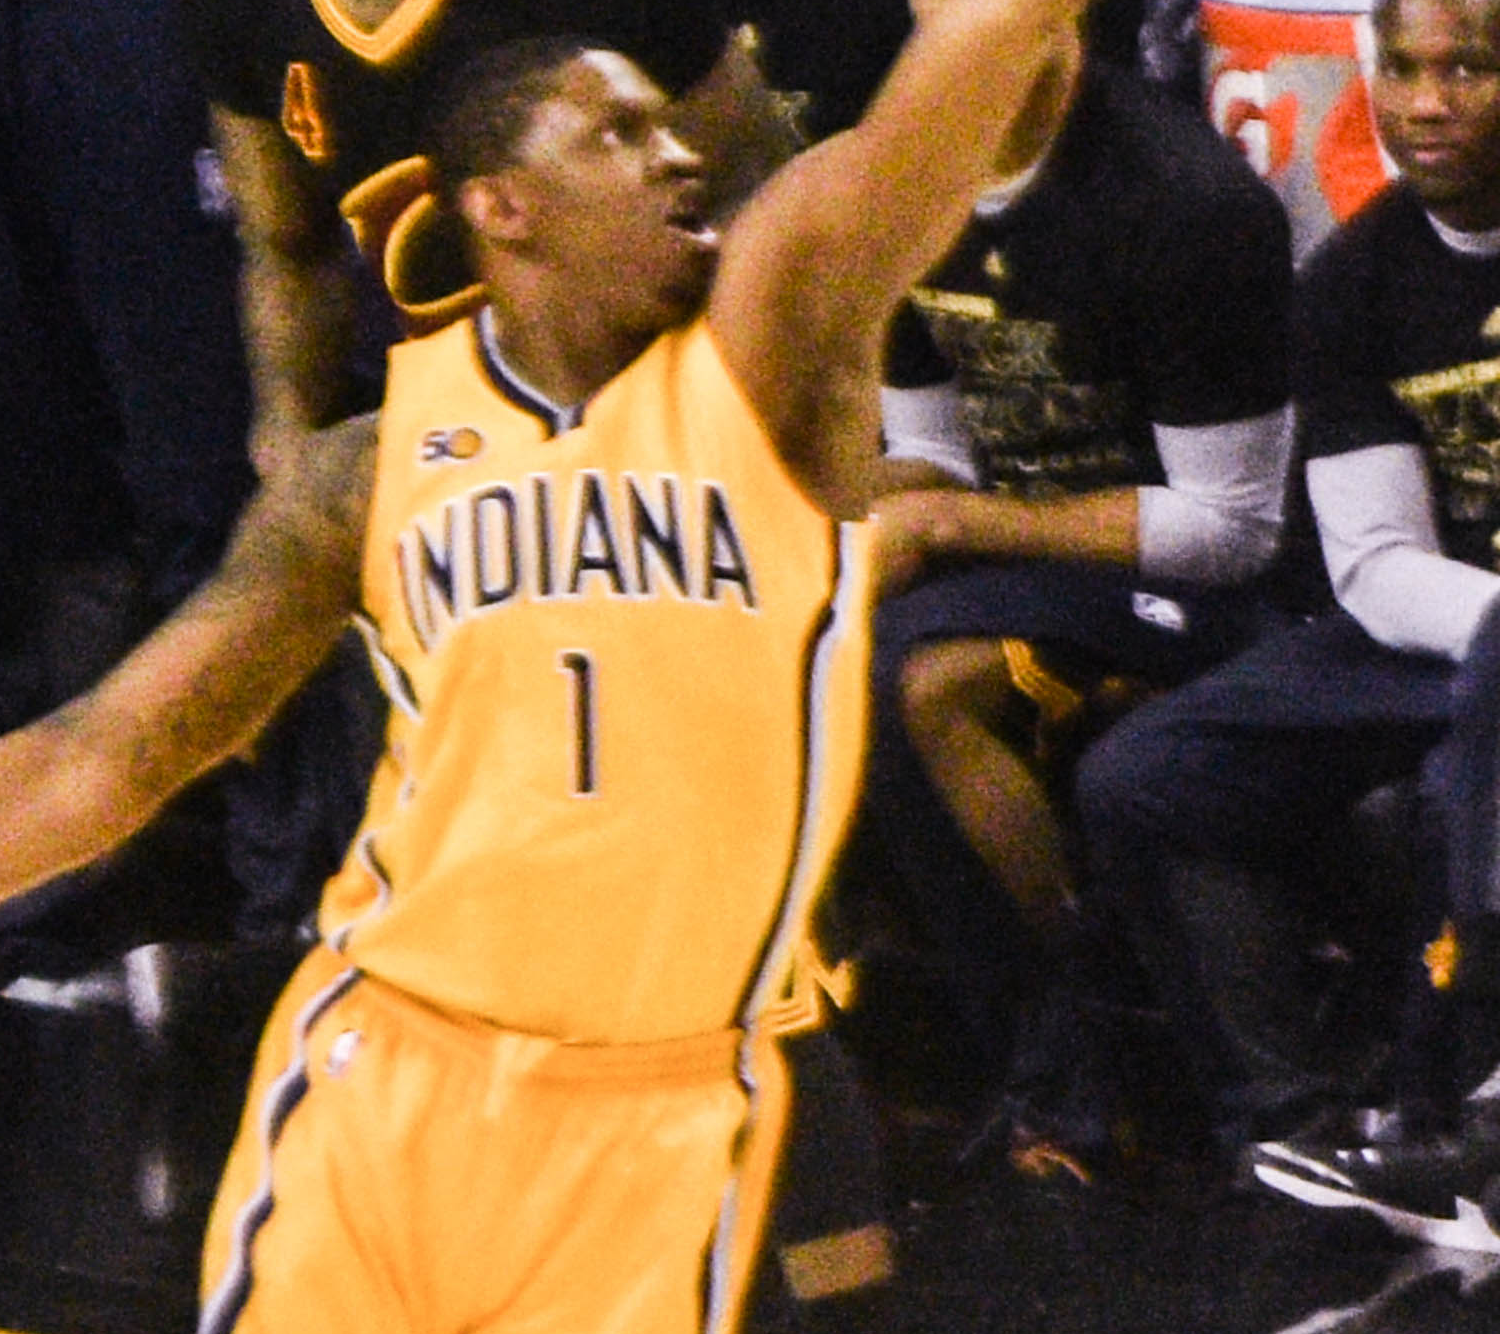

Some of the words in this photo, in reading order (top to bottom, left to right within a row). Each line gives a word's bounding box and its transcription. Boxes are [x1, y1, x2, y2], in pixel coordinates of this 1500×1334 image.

[282, 62, 328, 160] 4
[396, 467, 764, 657] INDIANA
[556, 647, 603, 799] 1
